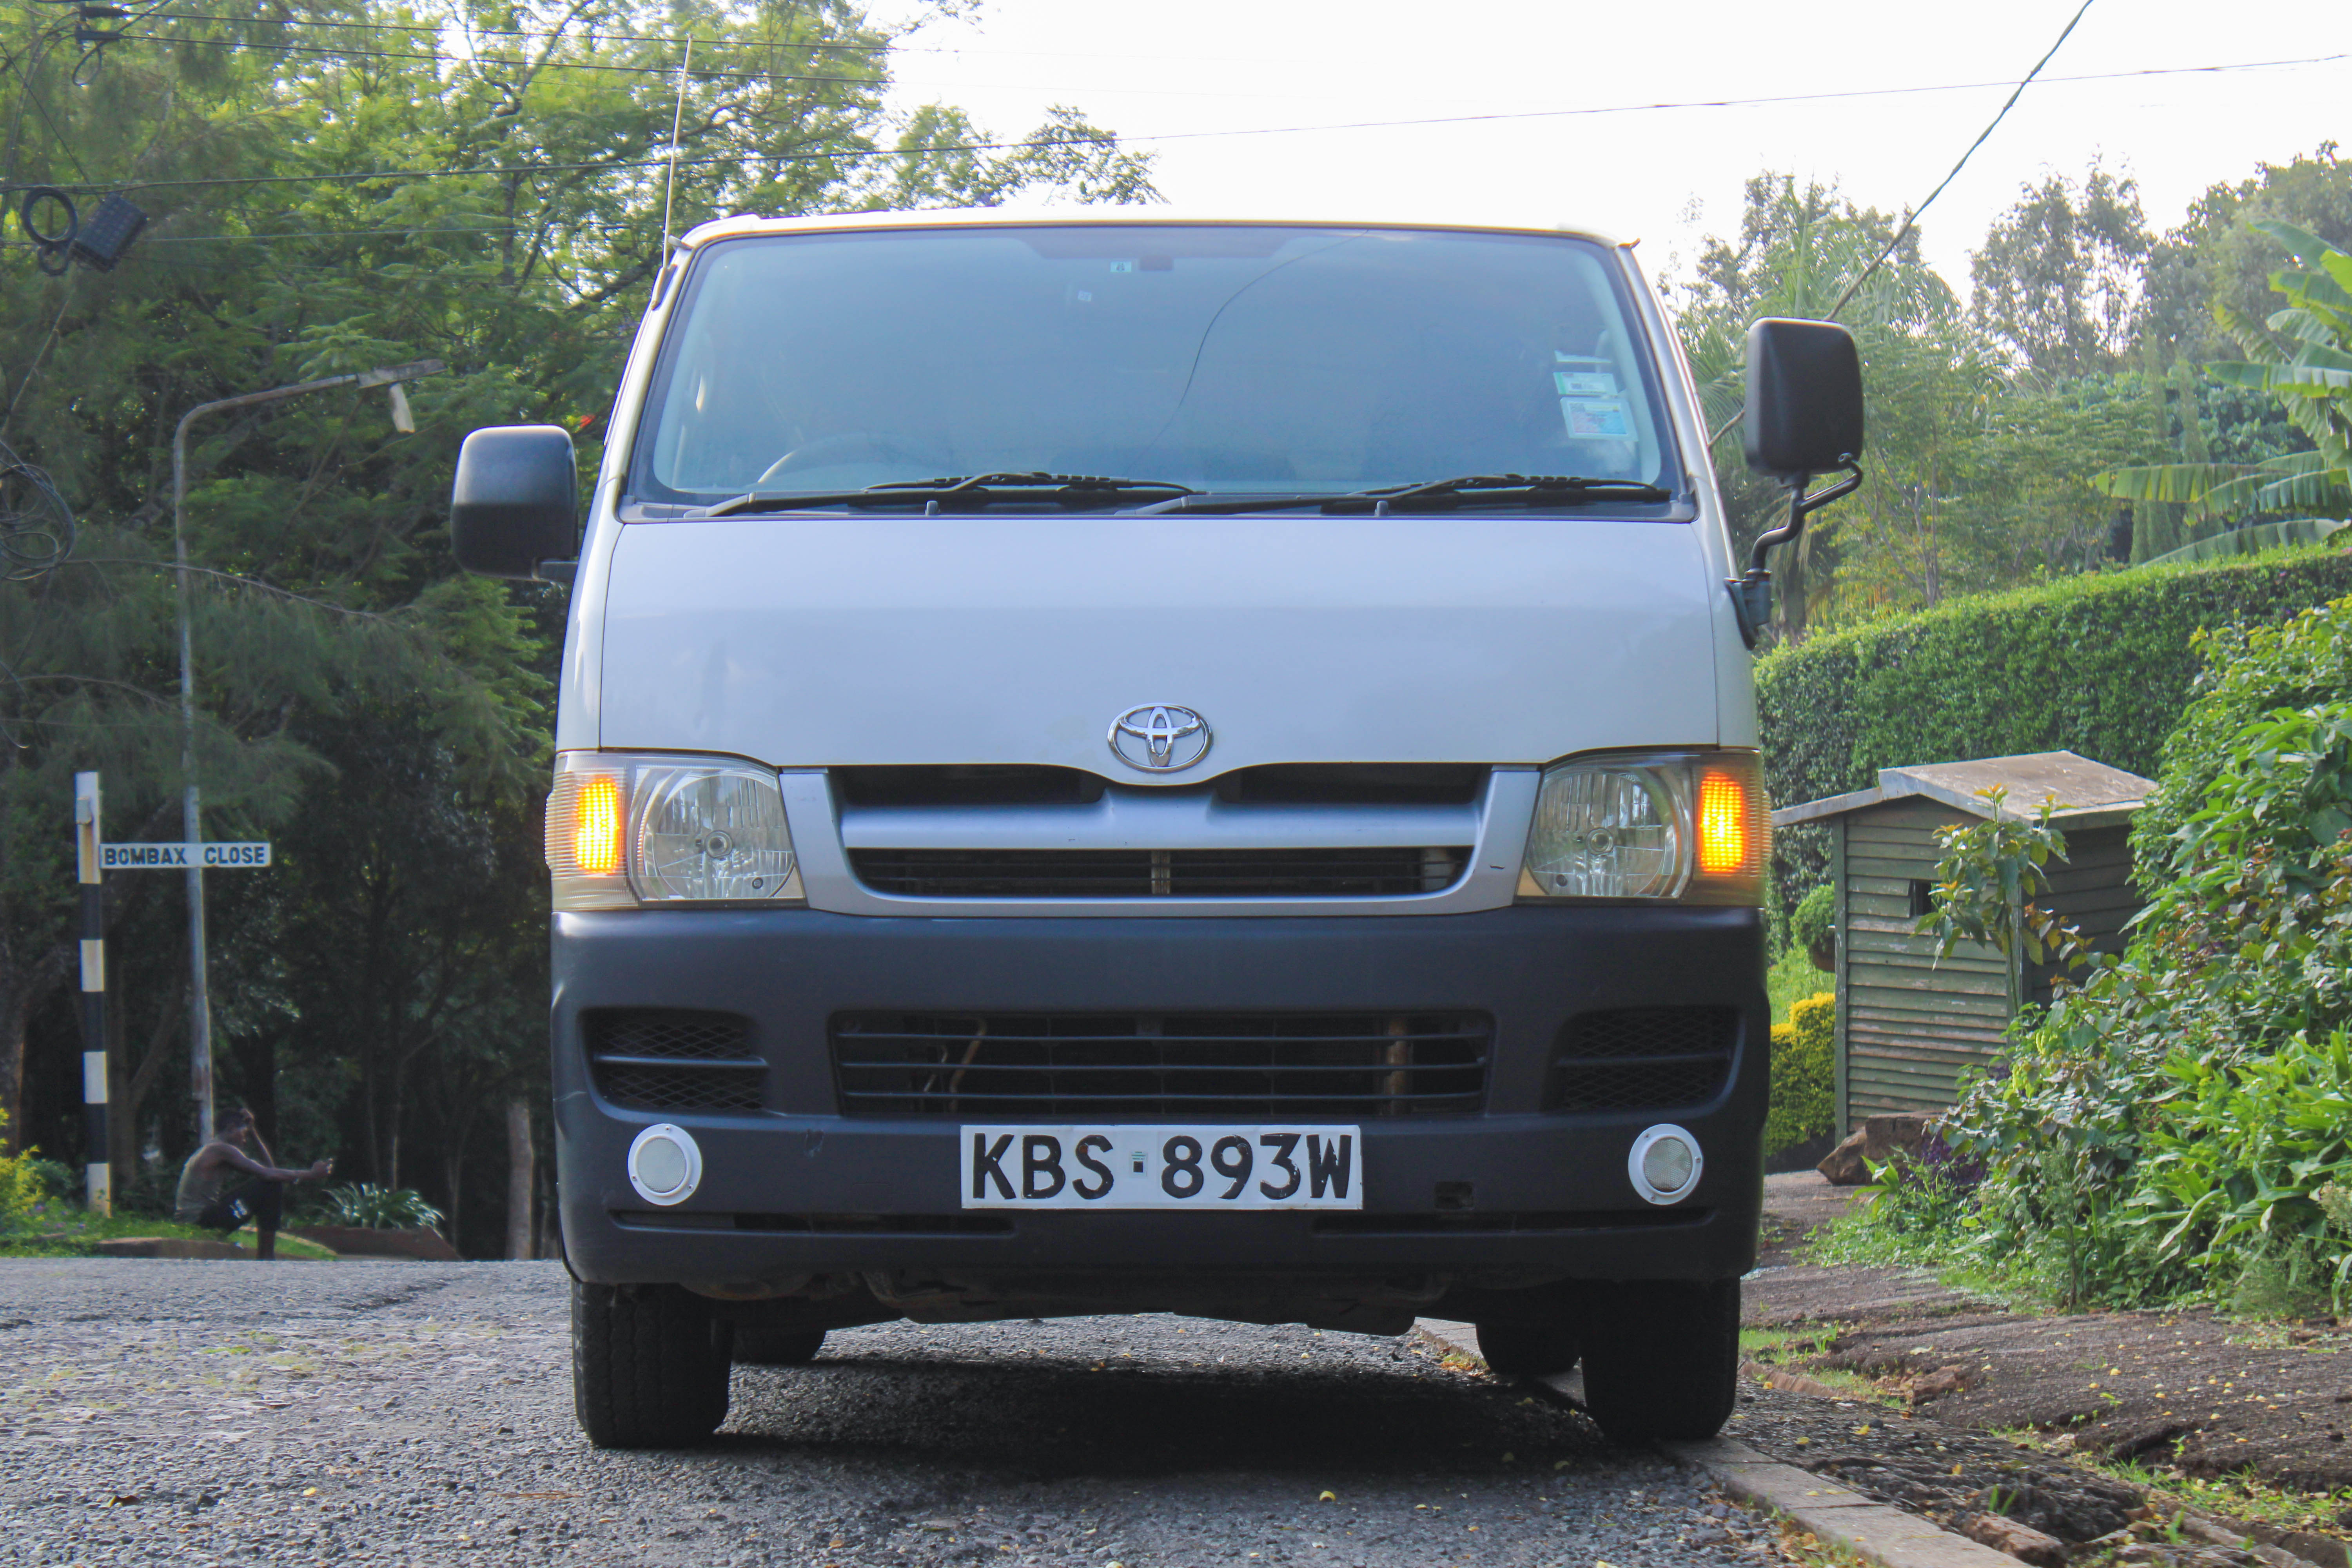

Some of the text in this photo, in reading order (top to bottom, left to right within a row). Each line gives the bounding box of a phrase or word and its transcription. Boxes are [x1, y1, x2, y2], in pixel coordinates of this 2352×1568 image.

[104, 847, 264, 865] BOMBAX CLOSE
[973, 1133, 1352, 1200] KBS 893W
